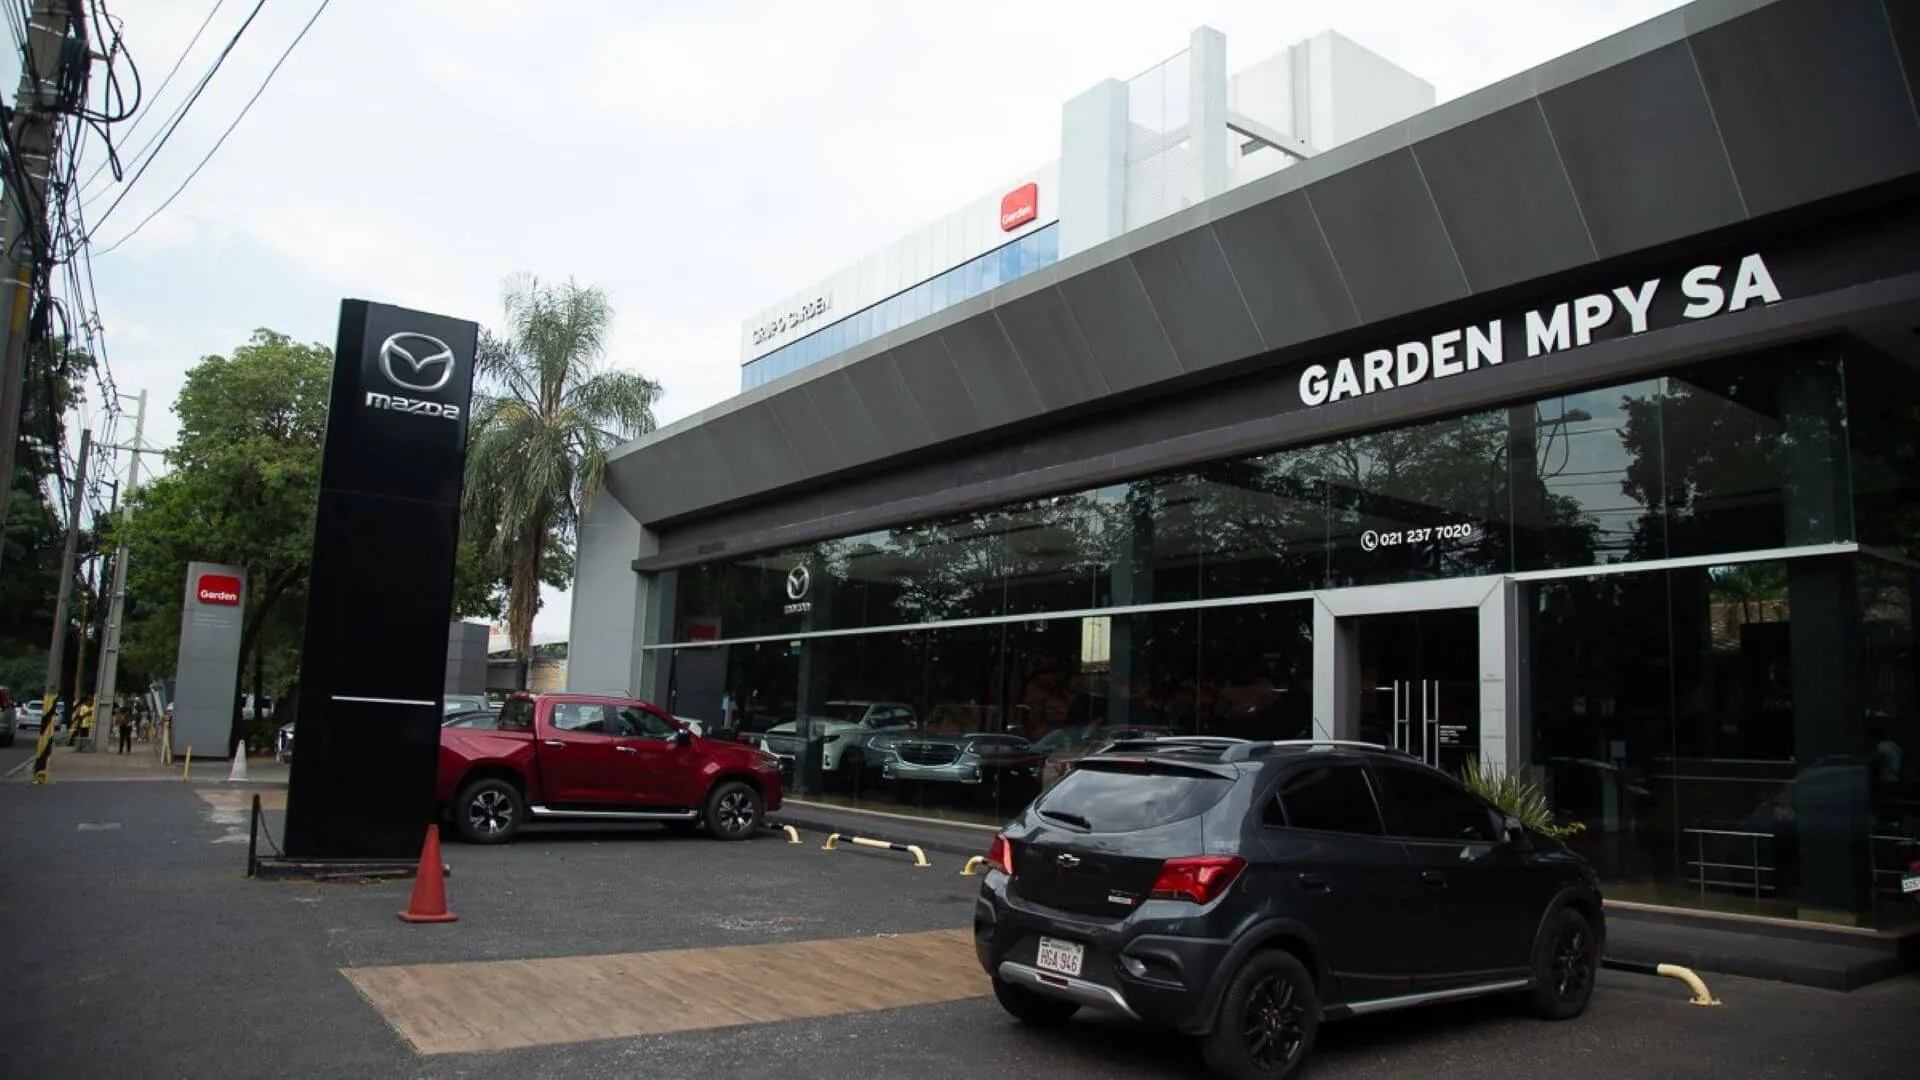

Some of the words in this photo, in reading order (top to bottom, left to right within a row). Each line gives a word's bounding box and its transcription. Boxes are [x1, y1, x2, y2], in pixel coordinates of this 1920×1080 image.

[1299, 319, 1503, 406] GARDEN
[1525, 279, 1660, 357] MPY
[1681, 253, 1782, 318] SA
[1380, 532, 1402, 546] 021
[1406, 528, 1432, 543] 237
[1435, 523, 1471, 540] 7020
[200, 589, 238, 601] Garden
